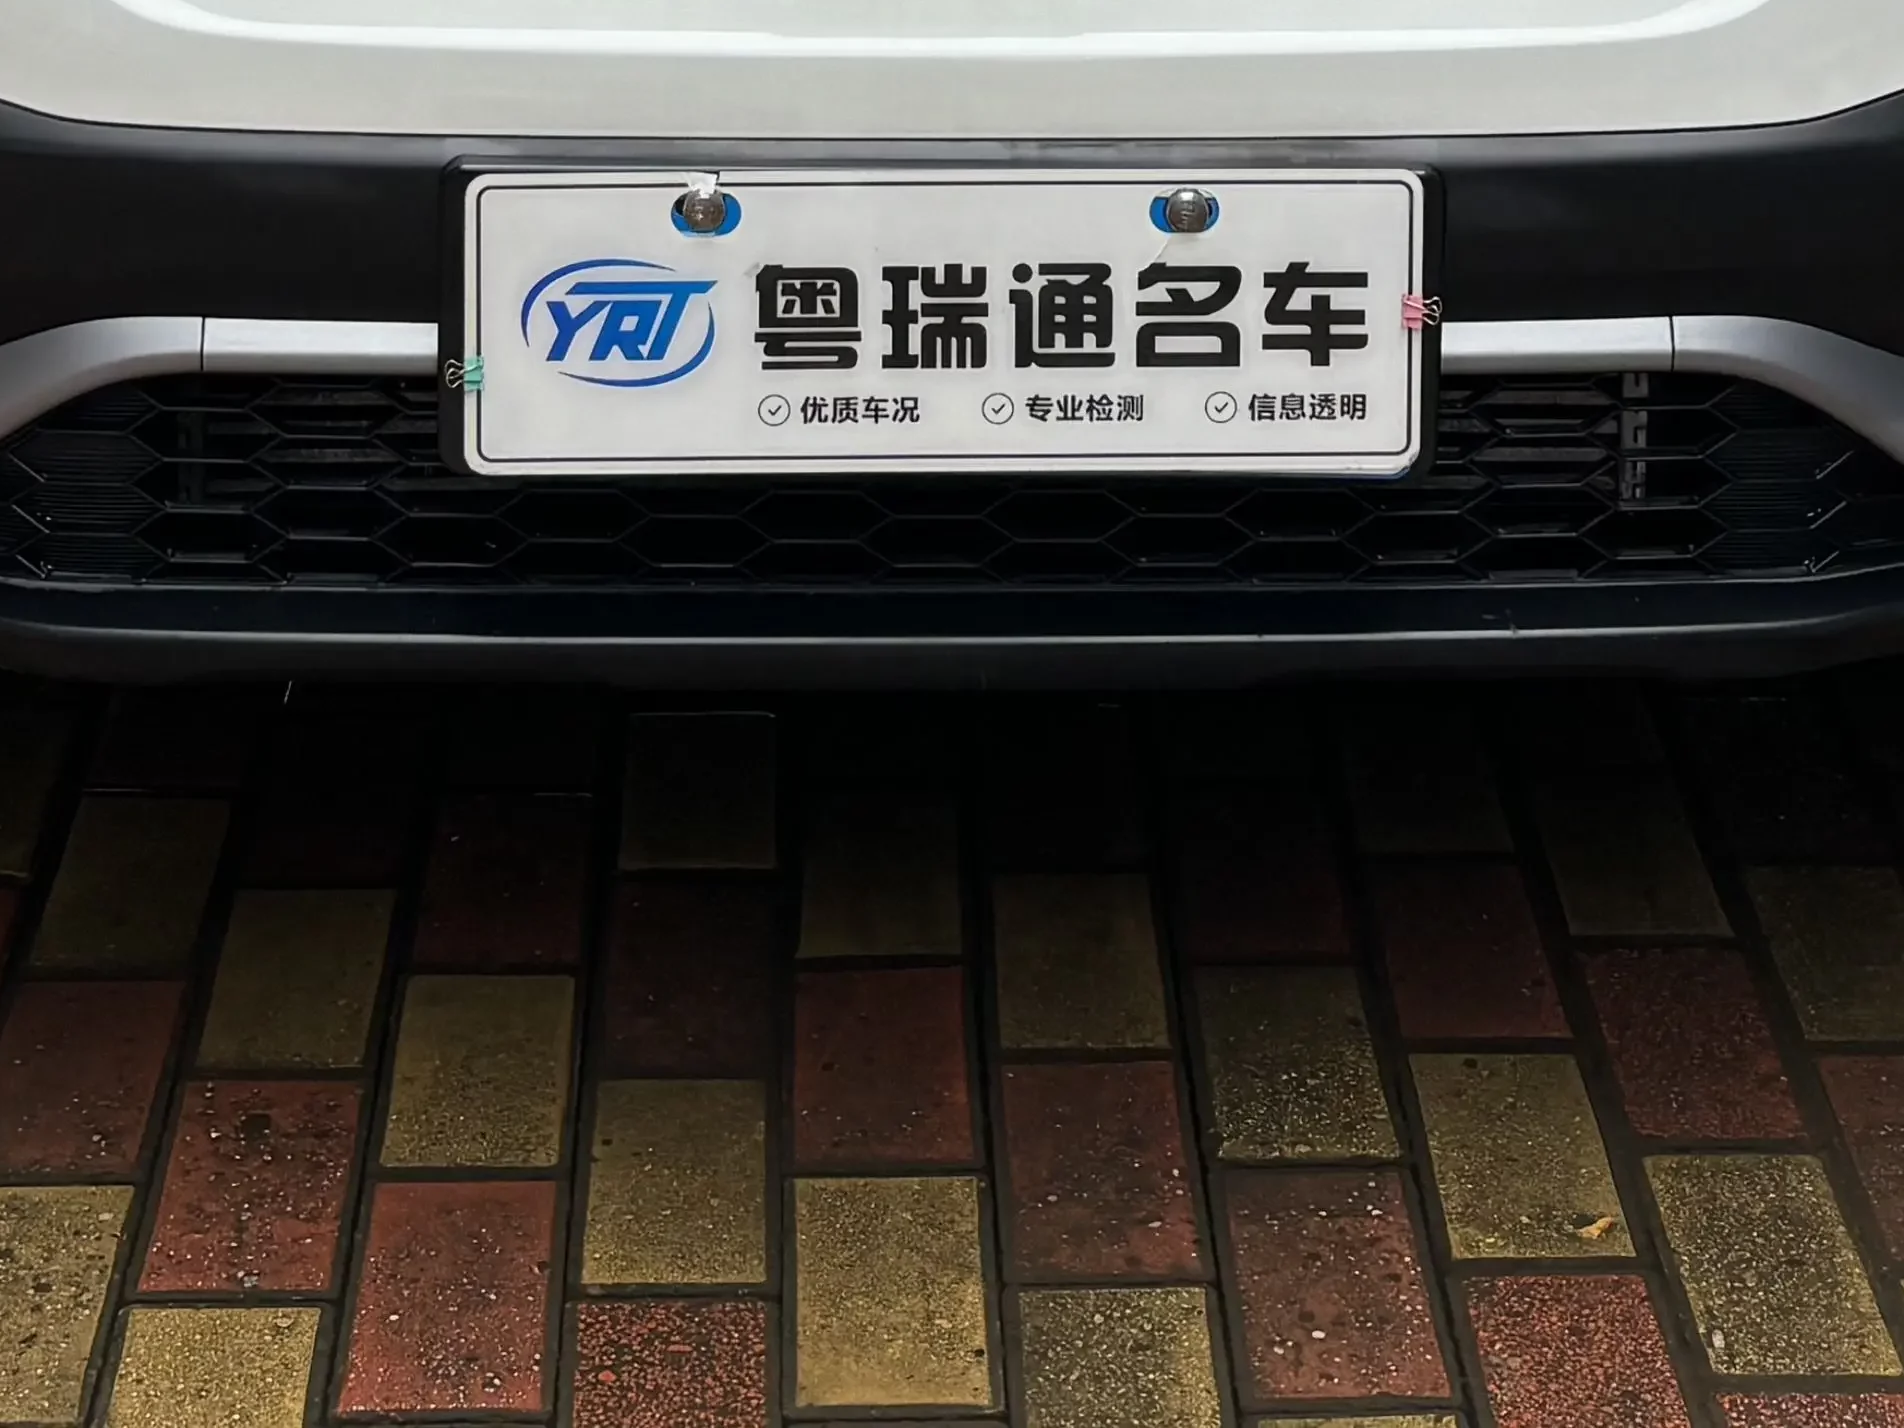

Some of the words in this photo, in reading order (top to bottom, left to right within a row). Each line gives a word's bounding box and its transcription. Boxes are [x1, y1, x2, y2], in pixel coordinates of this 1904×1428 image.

[545, 279, 719, 362] YRT
[753, 261, 1369, 371] 粤瑞通名车
[799, 395, 920, 425] 优质车况
[1025, 393, 1144, 423] 专业检测
[1247, 392, 1368, 423] 信息透明
